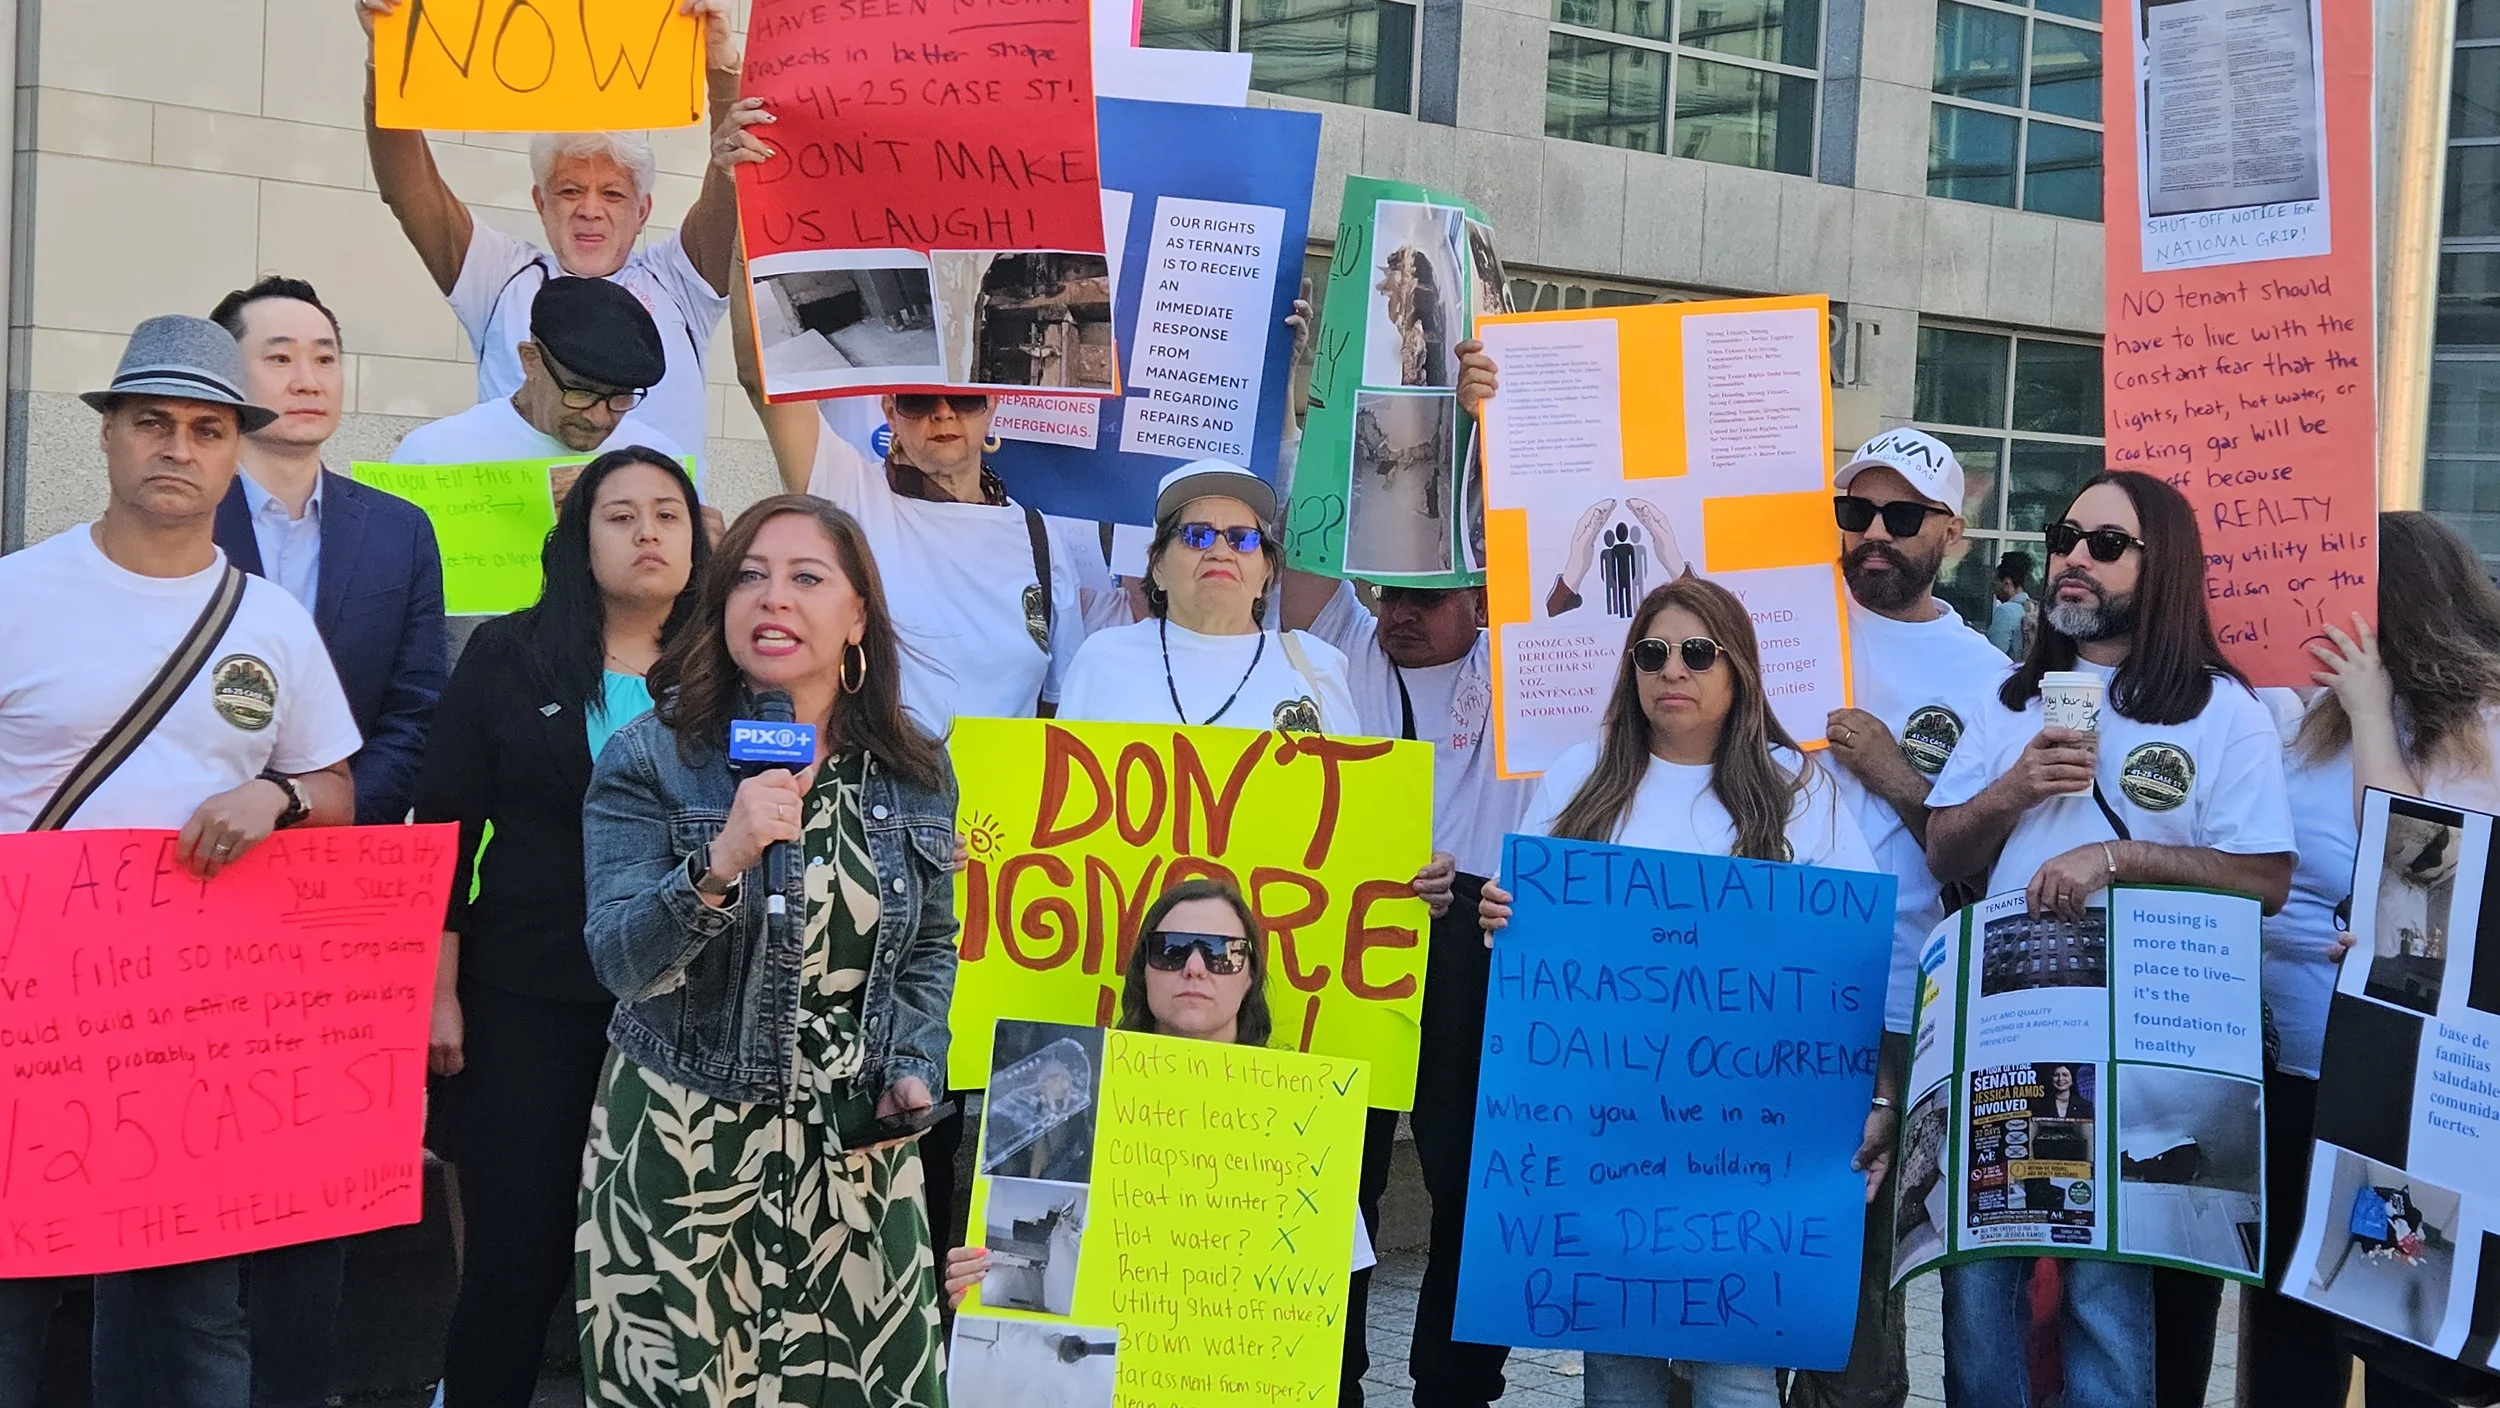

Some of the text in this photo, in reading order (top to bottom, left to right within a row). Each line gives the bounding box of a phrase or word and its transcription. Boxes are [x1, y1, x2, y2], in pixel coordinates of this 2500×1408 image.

[756, 4, 828, 43] HAVE
[399, 0, 700, 122] NOW!
[846, 48, 868, 61] in
[796, 78, 1080, 120] 41-25 CASE ST!
[756, 131, 1097, 191] DON'T MAKE
[762, 207, 1044, 250] US LAUGH!
[1170, 215, 1256, 235] OUR RIGHTS
[2147, 202, 2317, 235] SHUT-OFF NOTICE FOR
[1166, 237, 1261, 258] AS TERNANTS
[2157, 228, 2307, 262] NATIONAL GRID!
[1163, 258, 1261, 280] IS TO RECEIVE
[1159, 279, 1180, 292] AN
[2122, 275, 2332, 320] NO tenant should
[1156, 300, 1234, 320] IMMEDIATE
[1152, 322, 1229, 342] RESPONSE
[2114, 314, 2355, 356] have to live with the
[1149, 344, 1190, 360] FROM
[2215, 349, 2359, 377] fear that the
[1145, 366, 1249, 390] MANAGEMENT
[999, 394, 1096, 414] REPARACIONES
[1153, 389, 1239, 411] REGARDING
[2239, 393, 2267, 411] hot
[2336, 383, 2356, 396] or
[994, 416, 1092, 437] EMERGENCIAS.
[1139, 409, 1234, 432] REPAIRS AND
[1136, 431, 1244, 456] EMERGENCIES.
[2115, 415, 2330, 464] cooking gas will be
[473, 466, 512, 485] this
[522, 470, 533, 484] is
[2207, 465, 2294, 489] because
[2214, 496, 2332, 532] REALTY
[2242, 532, 2369, 564] utility bills
[2206, 570, 2365, 600] Edison or the
[1518, 636, 1596, 650] CONOZCA SUS
[2218, 617, 2270, 650] Grid!
[1584, 648, 1616, 658] HAGA
[1519, 662, 1596, 675] ESCUCHAR SU
[1520, 705, 1593, 718] INFORMADO.
[1929, 738, 1947, 749] CASE
[2153, 773, 2173, 784] CASE
[1030, 723, 1394, 871] DON'T
[1510, 838, 1880, 924] RETALIATION
[1985, 896, 2025, 914] TENANTS
[2132, 909, 2218, 930] Housing is
[1652, 921, 1699, 948] and
[2133, 938, 2230, 957] more than a
[72, 945, 153, 996] filed
[1498, 948, 1861, 1015] HARASSMENT is
[2133, 961, 2180, 979] place
[2183, 964, 2200, 979] to
[2133, 985, 2191, 1004] it's the
[78, 1004, 134, 1038] build
[148, 1003, 173, 1023] an
[2017, 1007, 2053, 1018] QUALITY
[2133, 1011, 2248, 1038] foundation for
[2134, 1037, 2196, 1058] healthy
[2439, 1023, 2490, 1050] base de
[14, 1055, 82, 1079] would
[107, 1045, 195, 1081] probably
[207, 1040, 230, 1060] be
[319, 1023, 374, 1045] than
[1491, 1033, 1504, 1055] a
[1528, 1021, 1672, 1083] DAILY
[1687, 1034, 1879, 1081] OCCURRENCE
[2435, 1045, 2491, 1073] familias
[1110, 1033, 1333, 1099] Rats in kitchen?
[1974, 1070, 2036, 1092] SENATOR
[182, 1046, 418, 1159] CASE ST
[1973, 1085, 2044, 1105] JESSICA RAMOS
[1974, 1099, 2027, 1117] INVOLVED
[1113, 1089, 1277, 1137] Water leaks?
[1590, 1095, 1785, 1137] you live in an
[2428, 1111, 2480, 1138] fuertes.
[1589, 1156, 1667, 1186] owned
[1113, 1177, 1170, 1208] Heat
[1180, 1187, 1197, 1208] in
[100, 1191, 307, 1249] THE HELL
[1114, 1218, 1151, 1248] Hot
[1497, 1206, 1834, 1259] WE DESERVE
[1118, 1253, 1242, 1295] Rent paid?
[1112, 1289, 1178, 1331] Utility
[1116, 1321, 1191, 1355] Brown
